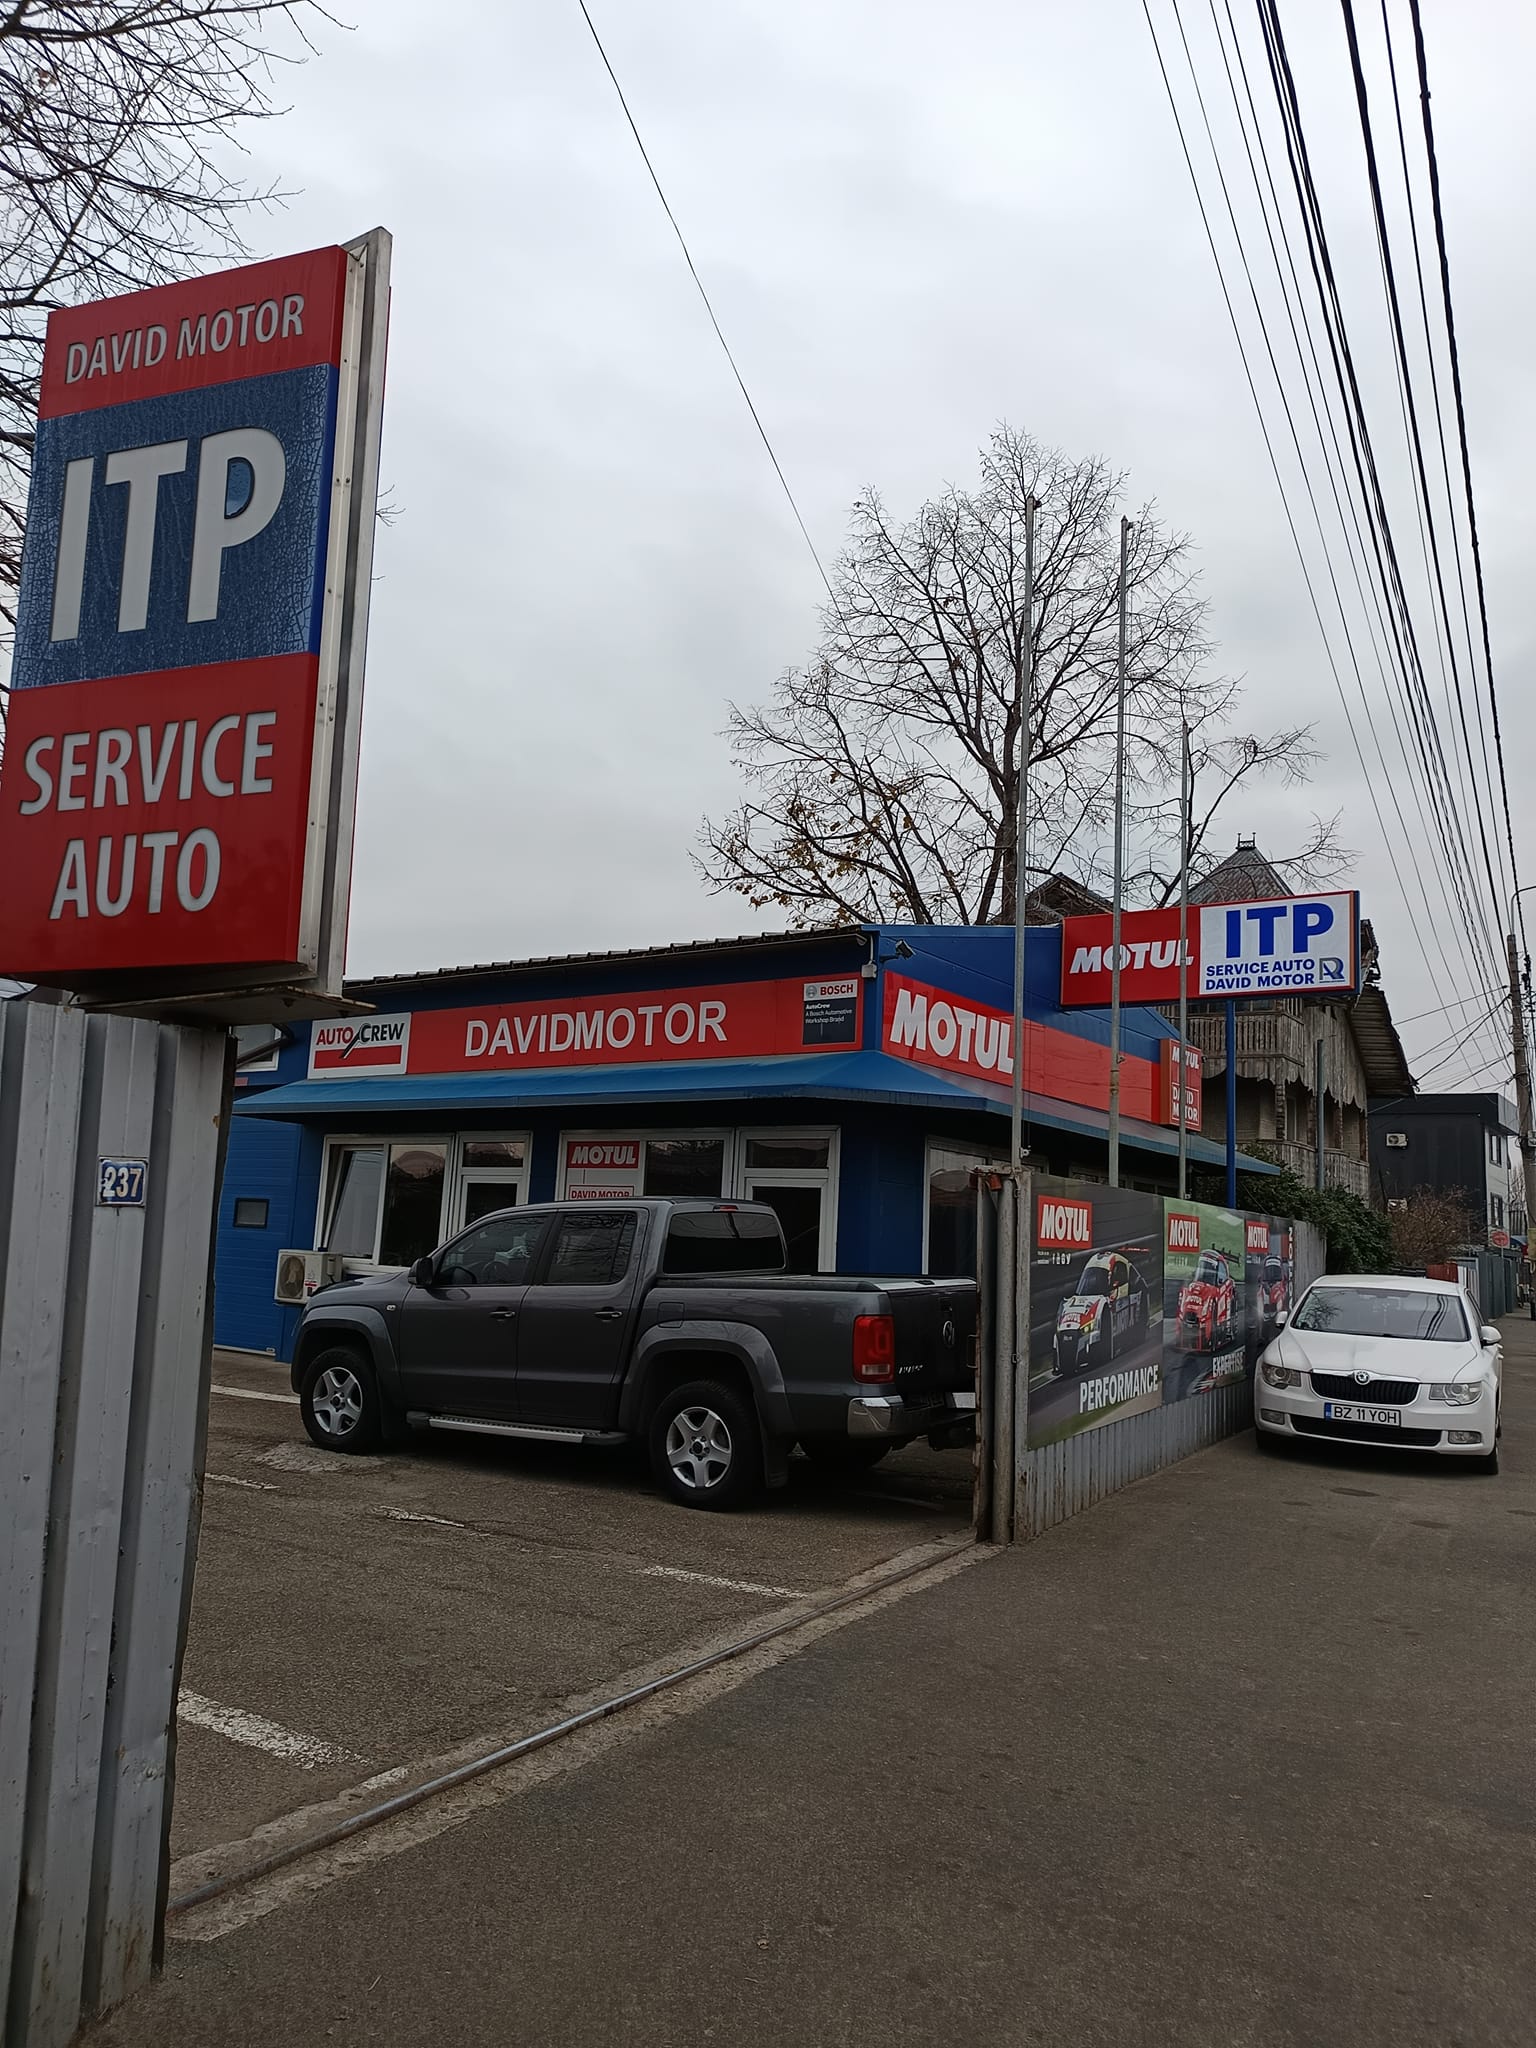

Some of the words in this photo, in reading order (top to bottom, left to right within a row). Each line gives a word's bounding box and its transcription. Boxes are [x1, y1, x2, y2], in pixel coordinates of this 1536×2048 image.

[66, 325, 168, 384] DAVID
[176, 295, 304, 358] MOTOR
[50, 427, 286, 642] ITP
[20, 712, 277, 816] SERVICE
[49, 828, 221, 920] AUTO
[1226, 902, 1334, 958] ITP
[1206, 961, 1269, 976] SERVICE
[1272, 958, 1315, 974] AUTO
[1206, 976, 1251, 990] DAVID
[1257, 973, 1315, 988] MOTOR
[820, 984, 853, 996] BOSCH
[316, 1026, 354, 1046] AUTO
[361, 1022, 405, 1043] CREW
[465, 1001, 727, 1057] DAVIDMOTOR
[890, 988, 1014, 1074] MOTUL
[1172, 1046, 1199, 1069] MTUL
[1173, 1103, 1198, 1122] MTOR
[571, 1145, 636, 1165] MOTUL
[102, 1166, 142, 1198] 237
[571, 1190, 597, 1199] DAVID
[1040, 1203, 1090, 1242] MOTUL
[1169, 1219, 1199, 1248] MOTUL
[1247, 1225, 1269, 1249] MOTUL
[1079, 1364, 1159, 1414] PERFORMANCE
[1334, 1406, 1352, 1419] BZ
[1357, 1408, 1366, 1421] 11
[1369, 1410, 1397, 1424] YOH
